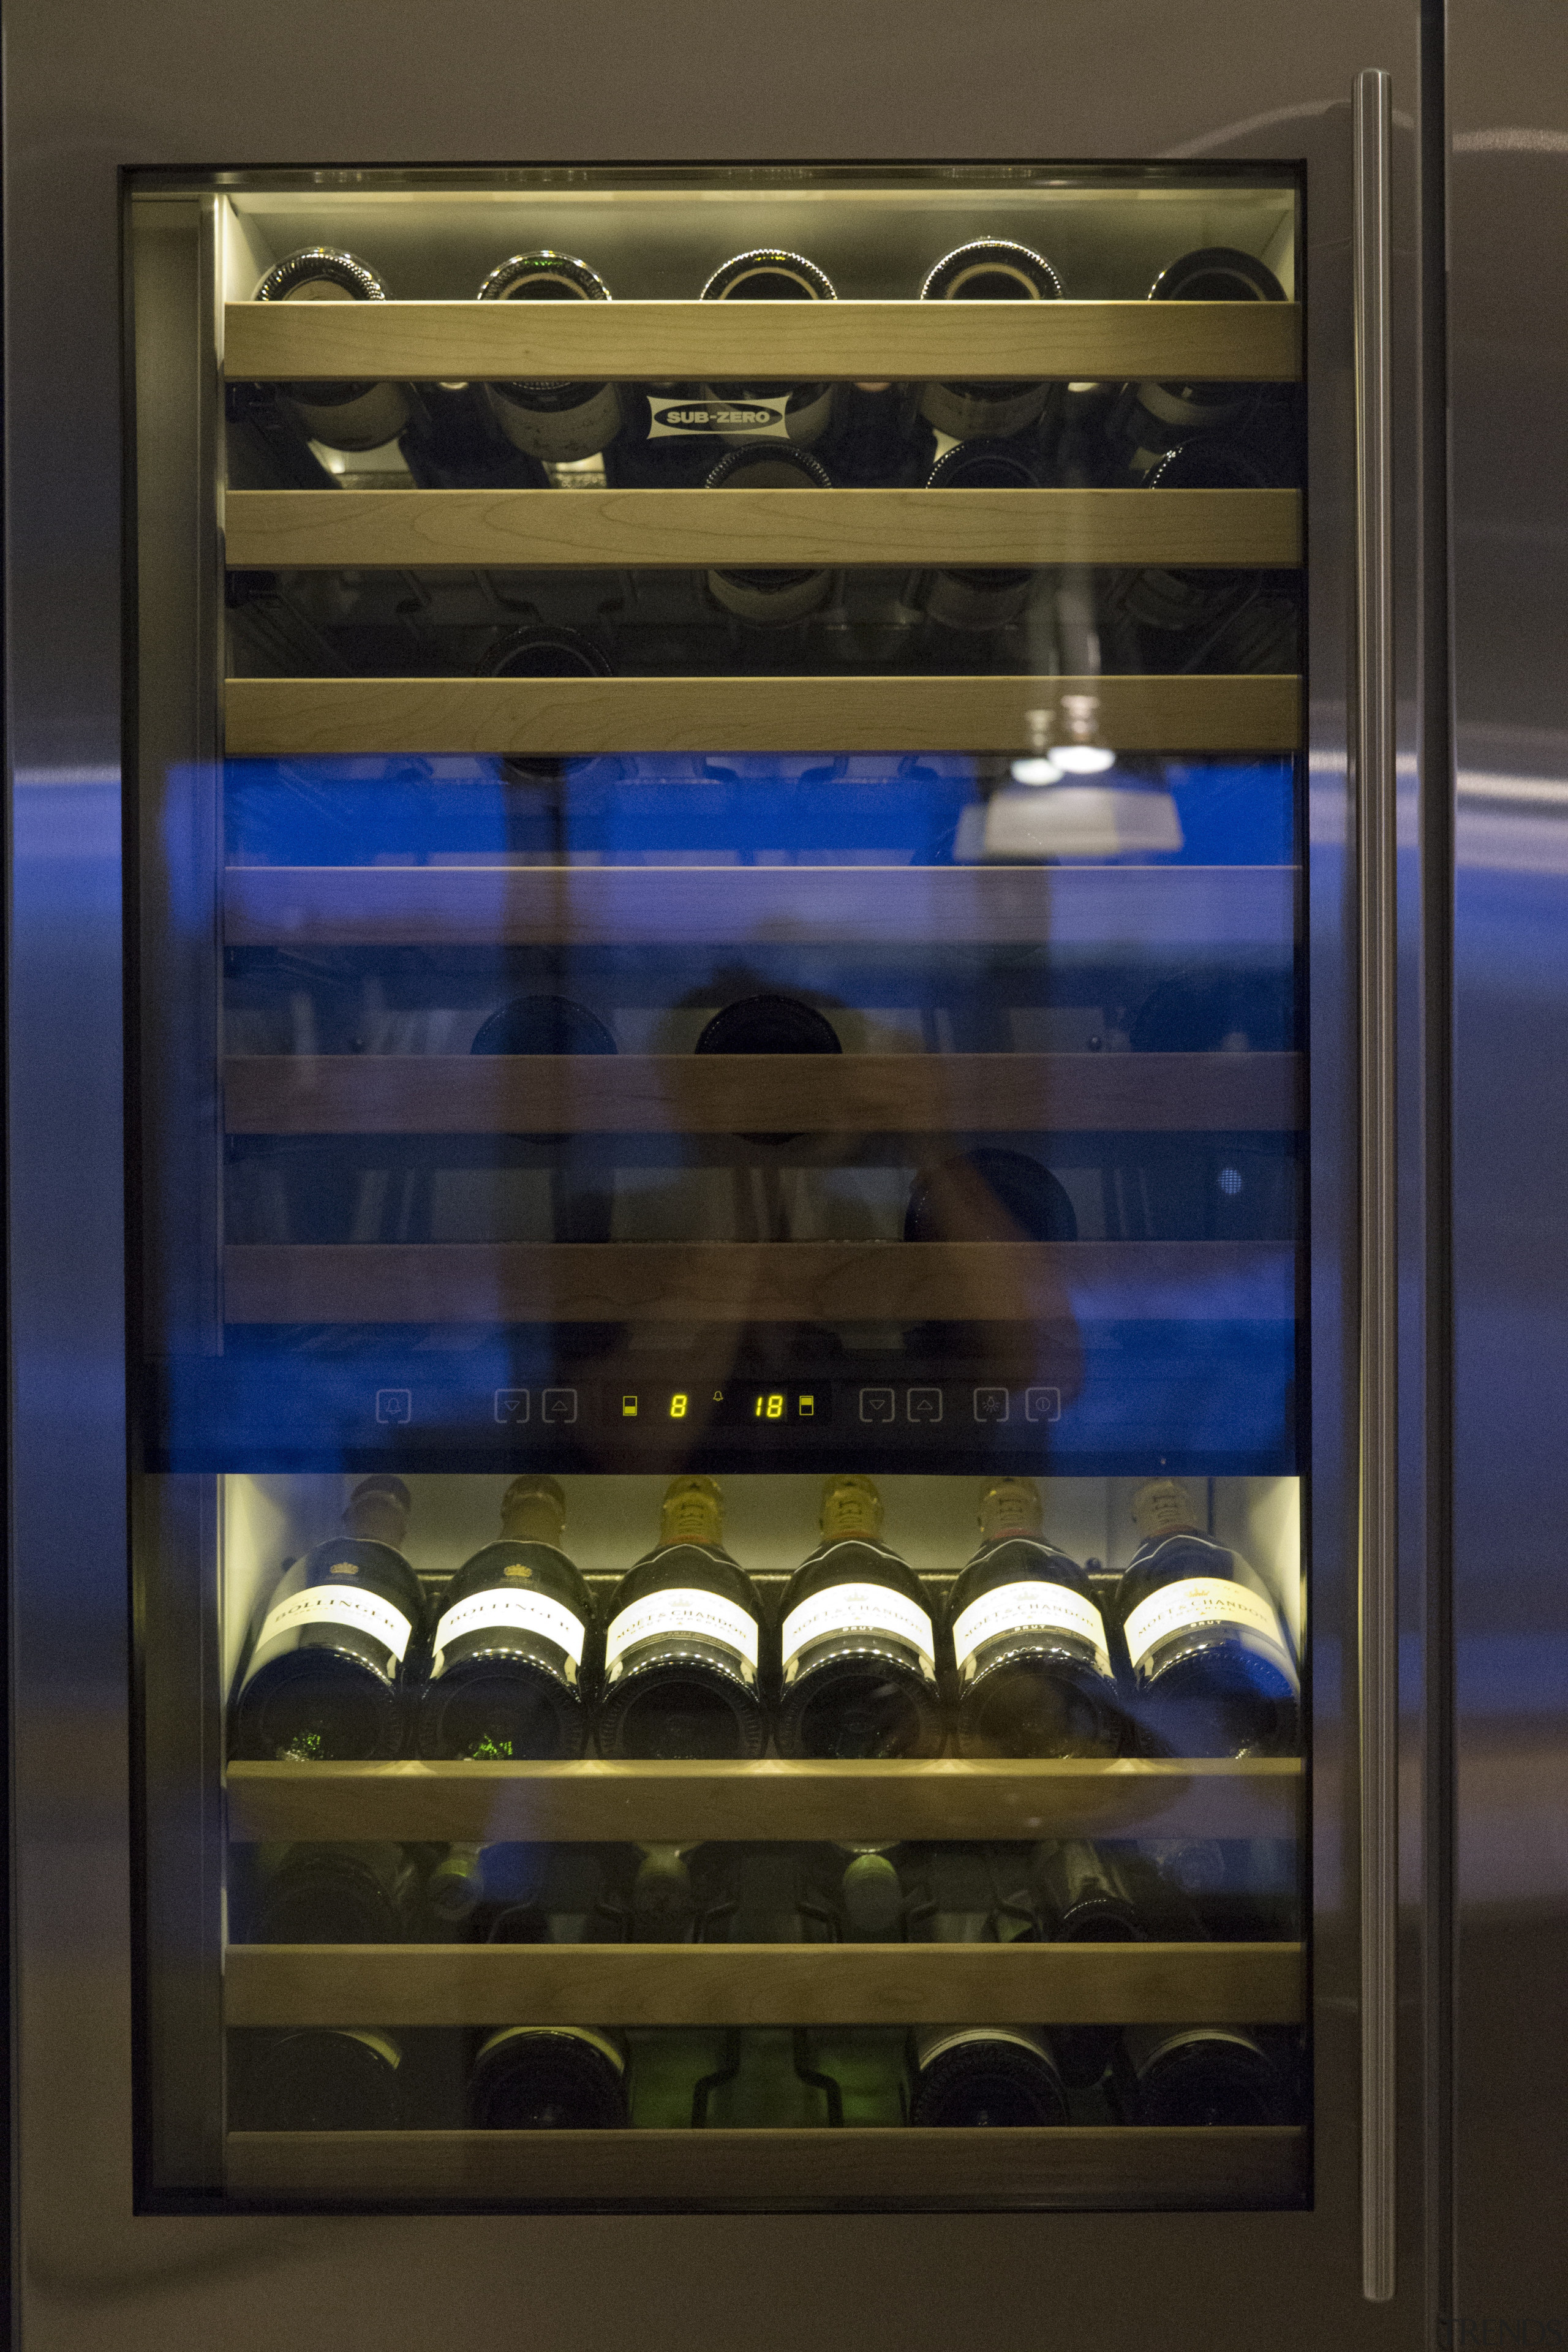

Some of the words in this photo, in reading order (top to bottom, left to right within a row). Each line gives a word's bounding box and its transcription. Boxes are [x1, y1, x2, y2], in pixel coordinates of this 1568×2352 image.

[666, 411, 771, 424] SUB-ZERO
[670, 1395, 687, 1418] 8
[756, 1395, 783, 1419] 18
